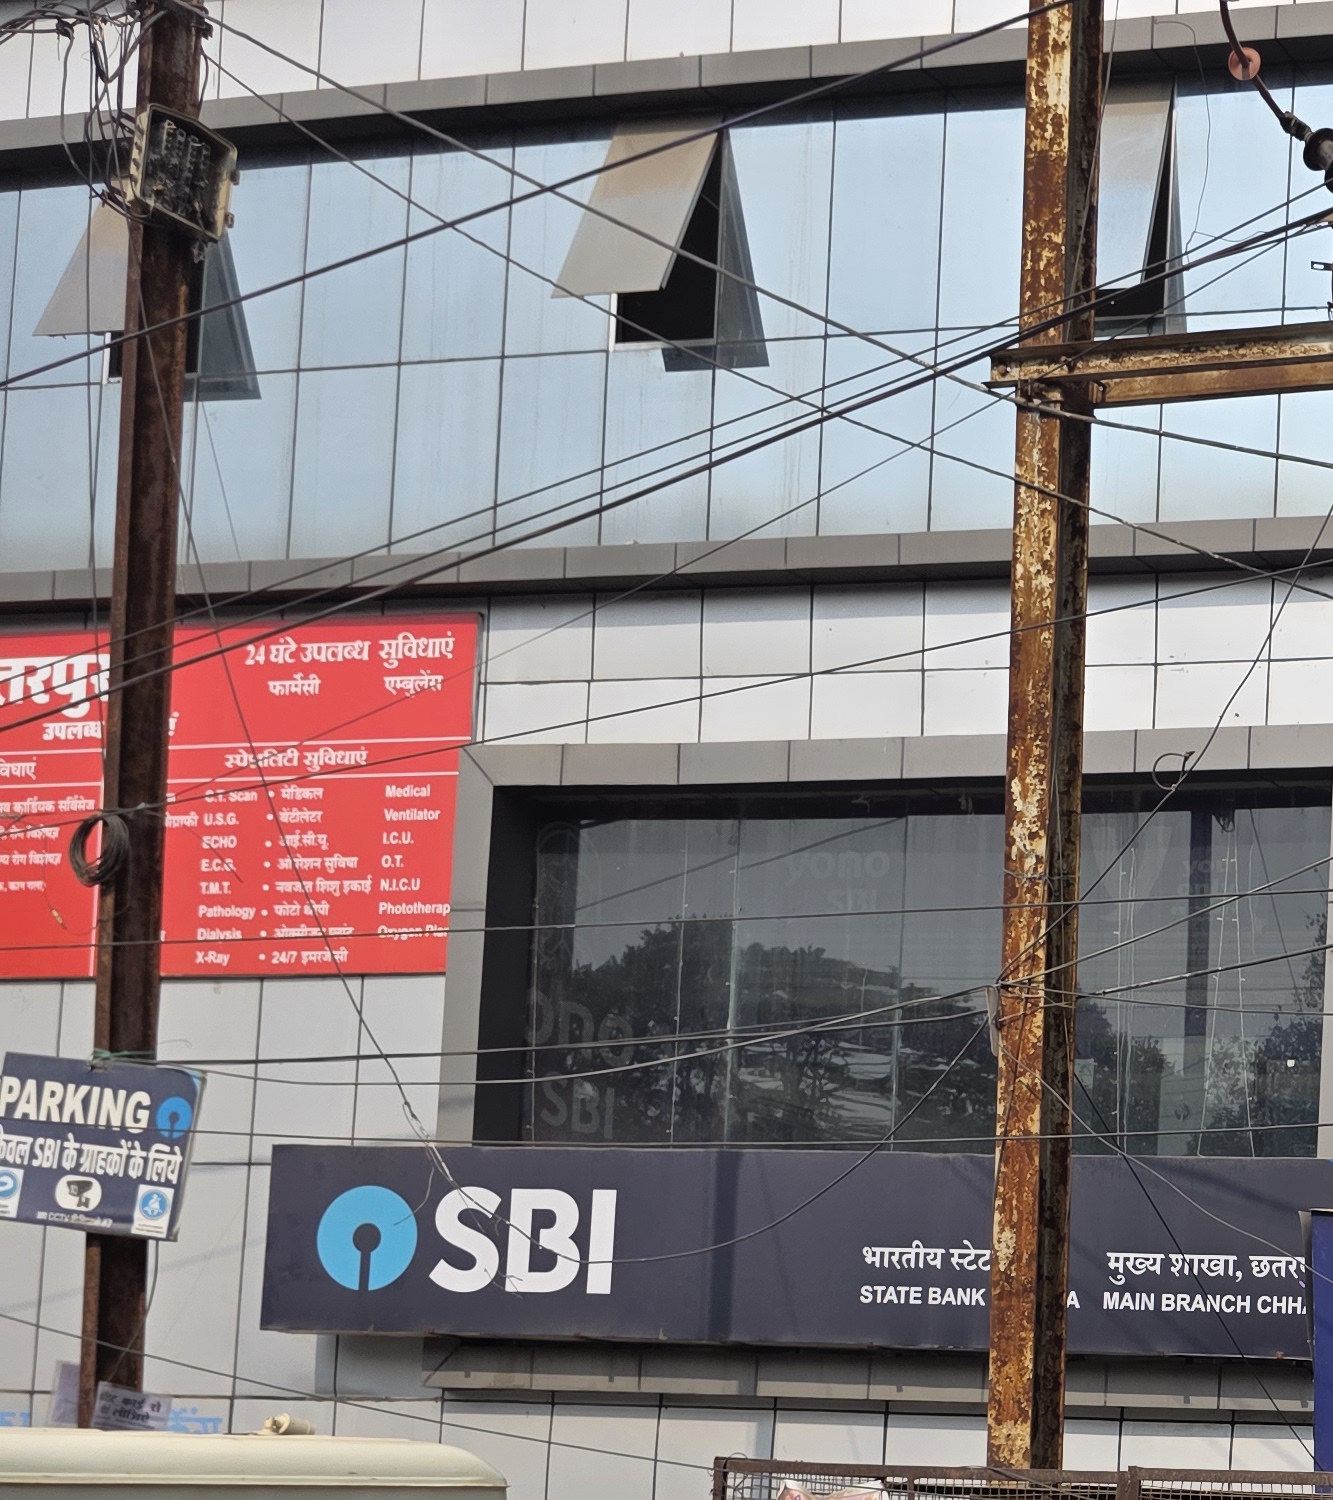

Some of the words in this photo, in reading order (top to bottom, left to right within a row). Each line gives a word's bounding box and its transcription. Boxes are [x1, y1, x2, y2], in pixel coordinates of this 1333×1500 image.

[245, 644, 266, 665] 24
[300, 641, 371, 662] उपलब्ध
[385, 784, 430, 798] Medical
[203, 812, 240, 826] U.S.G.
[384, 808, 441, 821] Ventilator
[202, 835, 238, 849] ECHO
[381, 854, 404, 868] O.T.
[198, 904, 256, 920] Pathology
[195, 951, 230, 966] X-Ray
[0, 1076, 151, 1134] PARKING
[32, 1137, 60, 1170] SBI
[429, 1185, 617, 1295] SBI
[862, 1239, 946, 1270] भारतीय
[1106, 1251, 1166, 1286] मुख्य
[1169, 1253, 1243, 1283] शाखा,
[859, 1285, 923, 1305] STATE
[928, 1287, 986, 1306] BANK
[1103, 1291, 1155, 1311] MAIN
[1161, 1293, 1251, 1314] BRANCH
[1257, 1295, 1307, 1315] CHH
